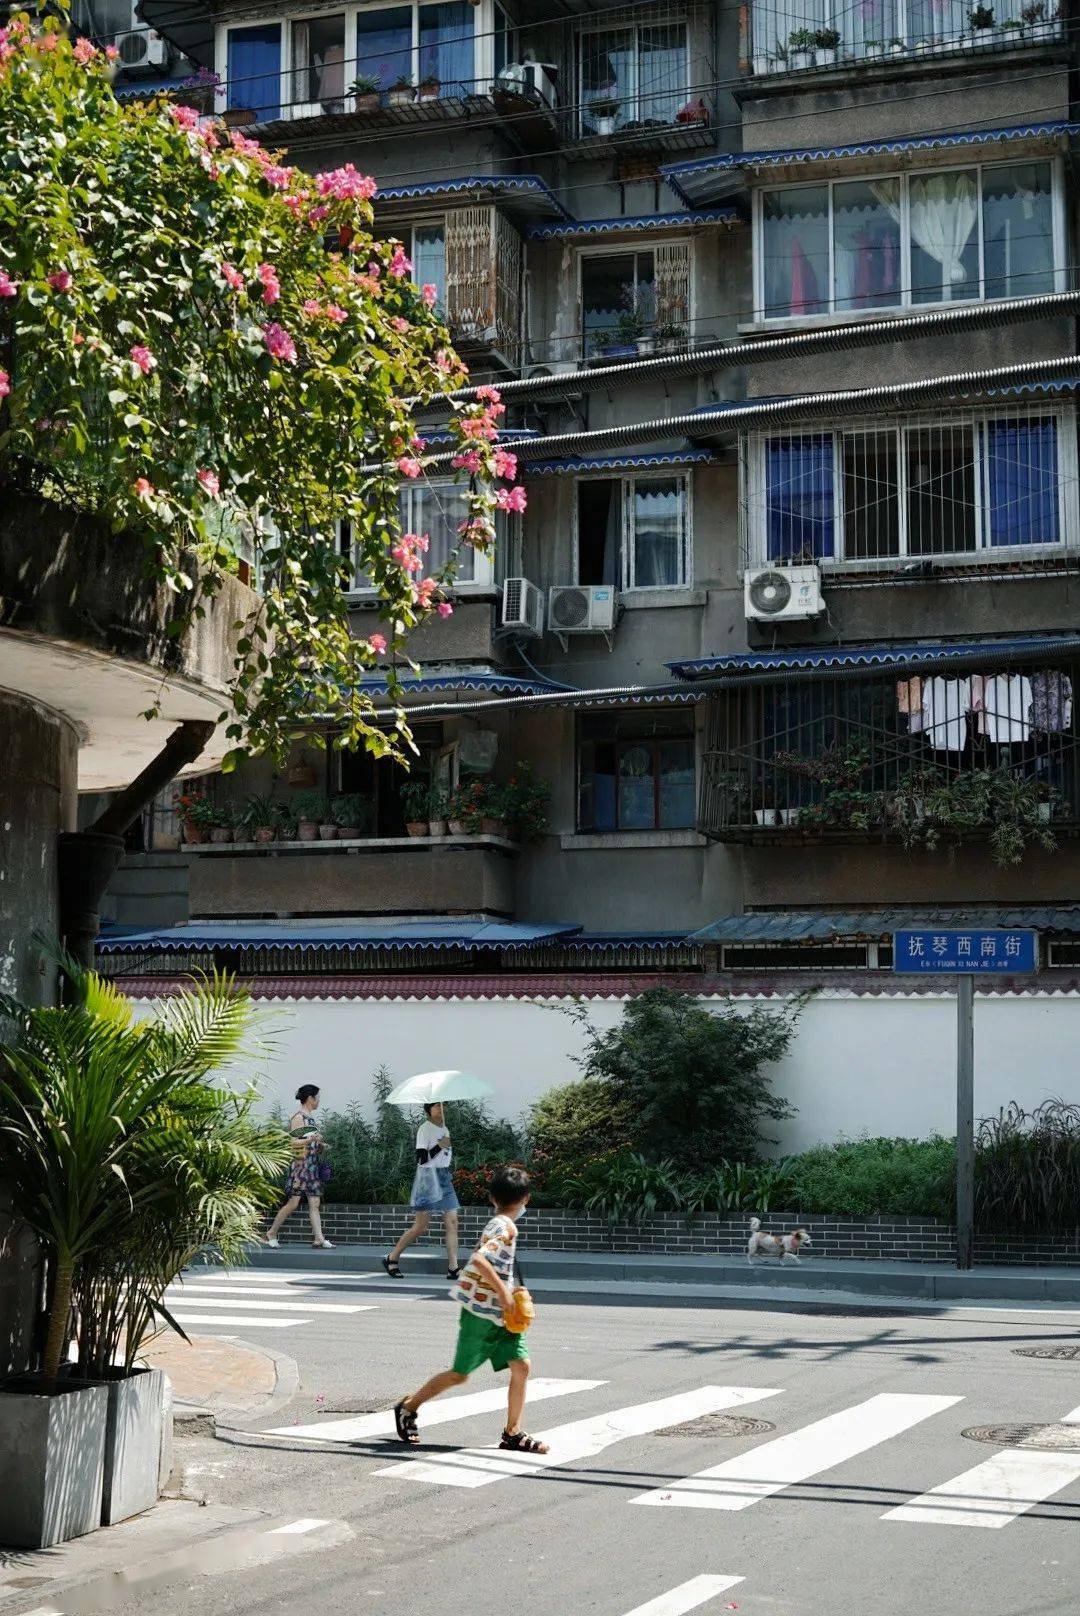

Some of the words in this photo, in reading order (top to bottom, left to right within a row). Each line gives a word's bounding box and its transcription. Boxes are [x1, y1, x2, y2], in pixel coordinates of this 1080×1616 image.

[908, 936, 1021, 957] 抚琴西南街
